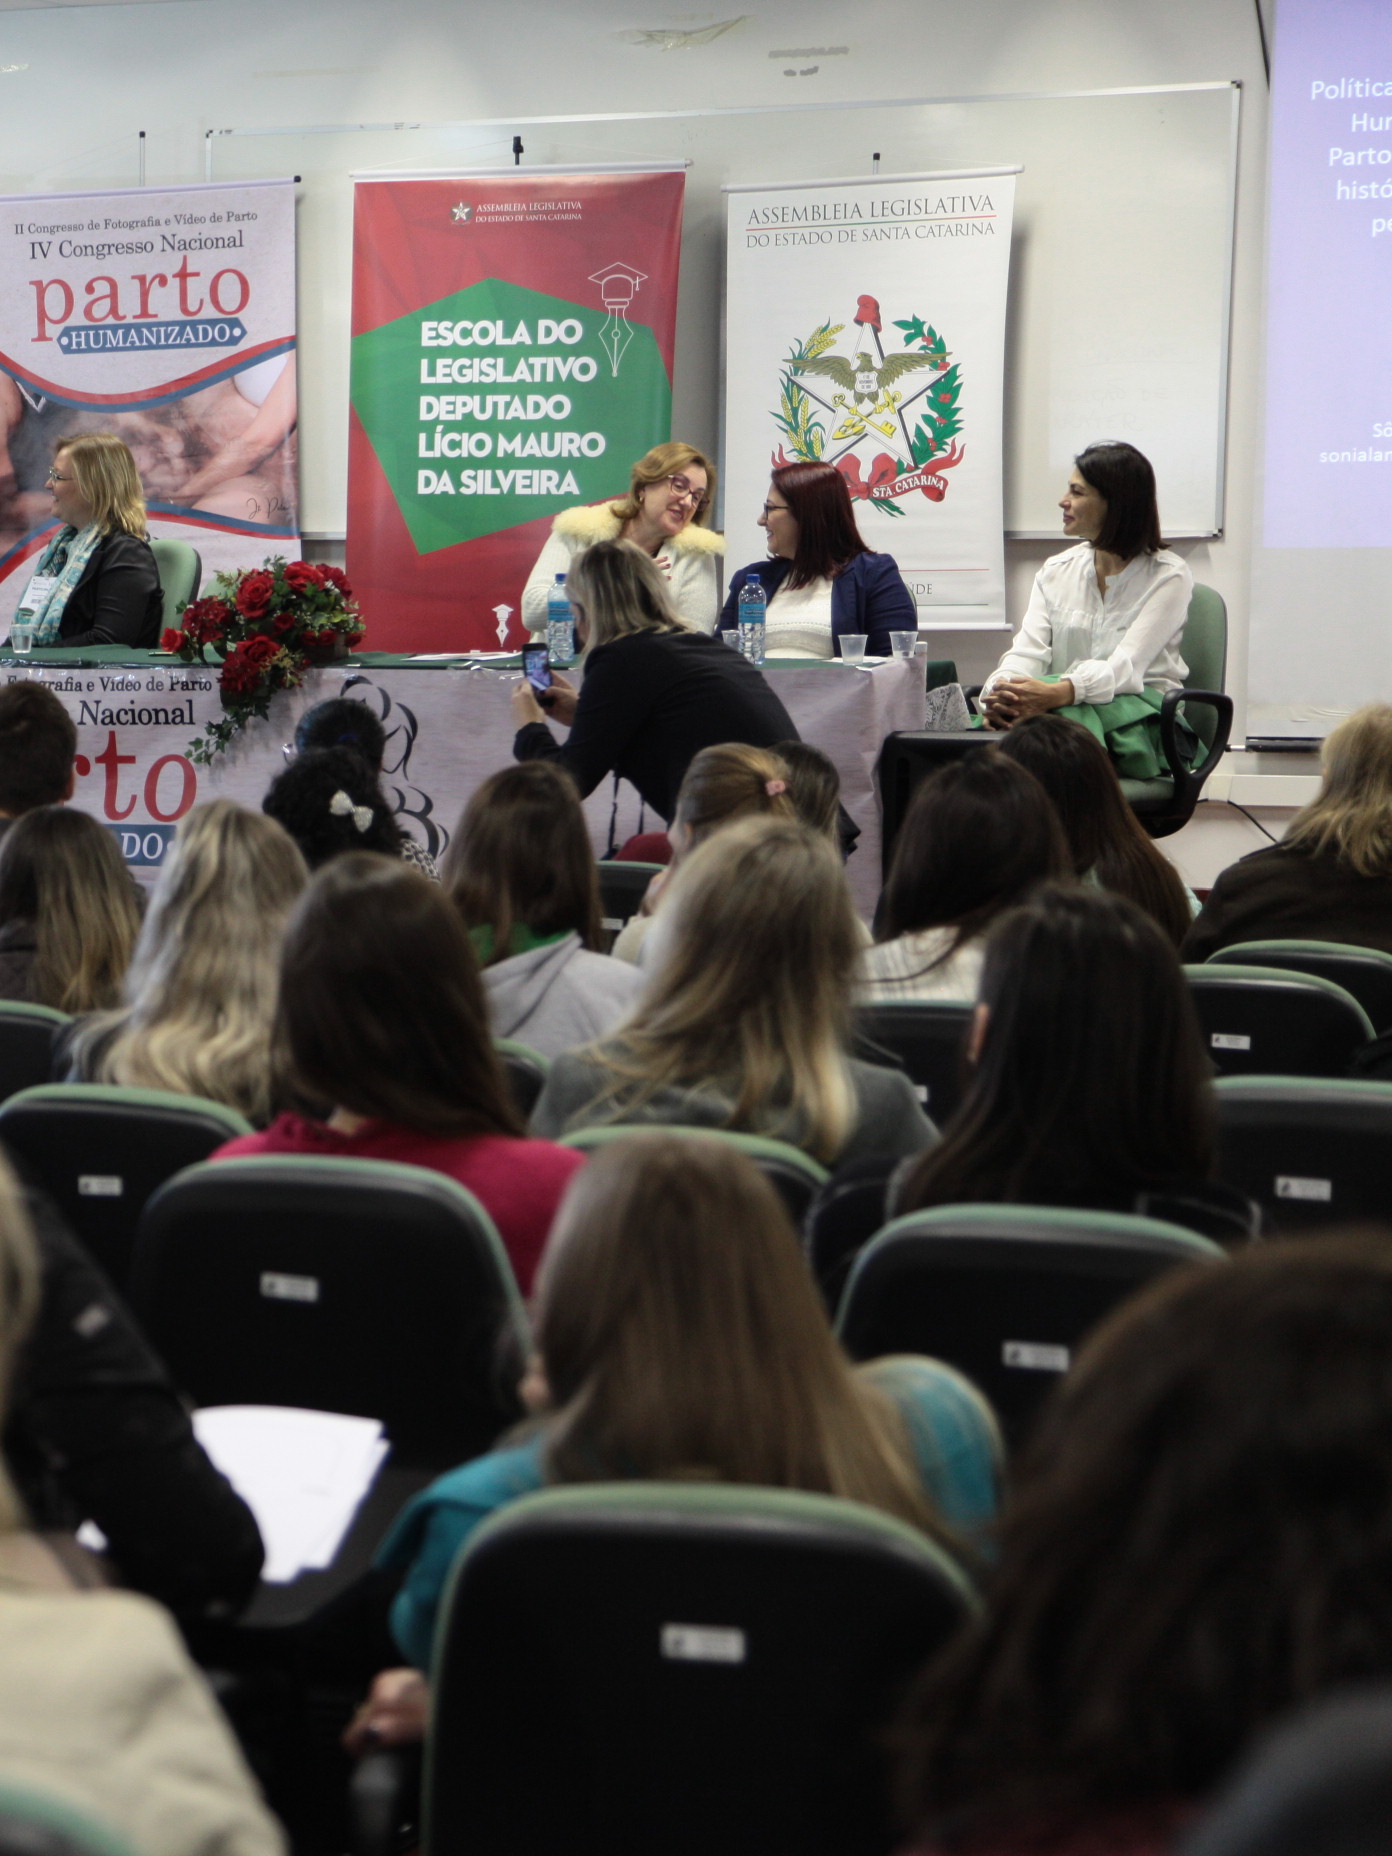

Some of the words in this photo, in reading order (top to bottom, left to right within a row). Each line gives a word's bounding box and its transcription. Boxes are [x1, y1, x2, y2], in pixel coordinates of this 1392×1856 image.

[1328, 147, 1392, 167] Parto
[475, 215, 487, 223] DO
[488, 214, 514, 222] ESTADO
[548, 213, 582, 221] CATARINA
[476, 203, 528, 213] ASSEMBLEIA
[529, 201, 582, 211] LEGISLATIVA
[748, 203, 863, 225] ASSEMBLEIA
[870, 194, 996, 218] LEGISLATIVA
[14, 224, 25, 235] II
[27, 222, 85, 237] Congresso
[87, 220, 101, 231] de
[103, 215, 161, 233] Fotografia
[164, 218, 172, 226] e
[174, 213, 207, 225] Vídeo
[209, 212, 223, 223] de
[226, 211, 258, 222] Parto
[746, 234, 770, 248] DO
[775, 231, 833, 247] ESTADO
[838, 228, 857, 243] DE
[862, 226, 911, 242] SANTA
[914, 222, 996, 240] CATARINA
[29, 240, 53, 260] IV
[58, 238, 154, 261] Congresso
[160, 230, 245, 253] Nacional
[29, 254, 251, 343] parto
[70, 323, 231, 350] HUMANIZADO
[421, 320, 532, 347] ESCOLA
[537, 318, 583, 345] DO
[420, 356, 598, 384] LEGISLATIVO
[419, 394, 572, 421] DEPUTADO
[418, 425, 493, 458] LÍCIO
[496, 432, 606, 458] MAURO
[417, 469, 456, 495] DA
[459, 469, 580, 495] SILVEIRA
[872, 487, 896, 498] STA.
[895, 475, 945, 493] CATARINA
[87, 681, 94, 692] e
[146, 677, 164, 691] de
[77, 699, 196, 726] Nacional
